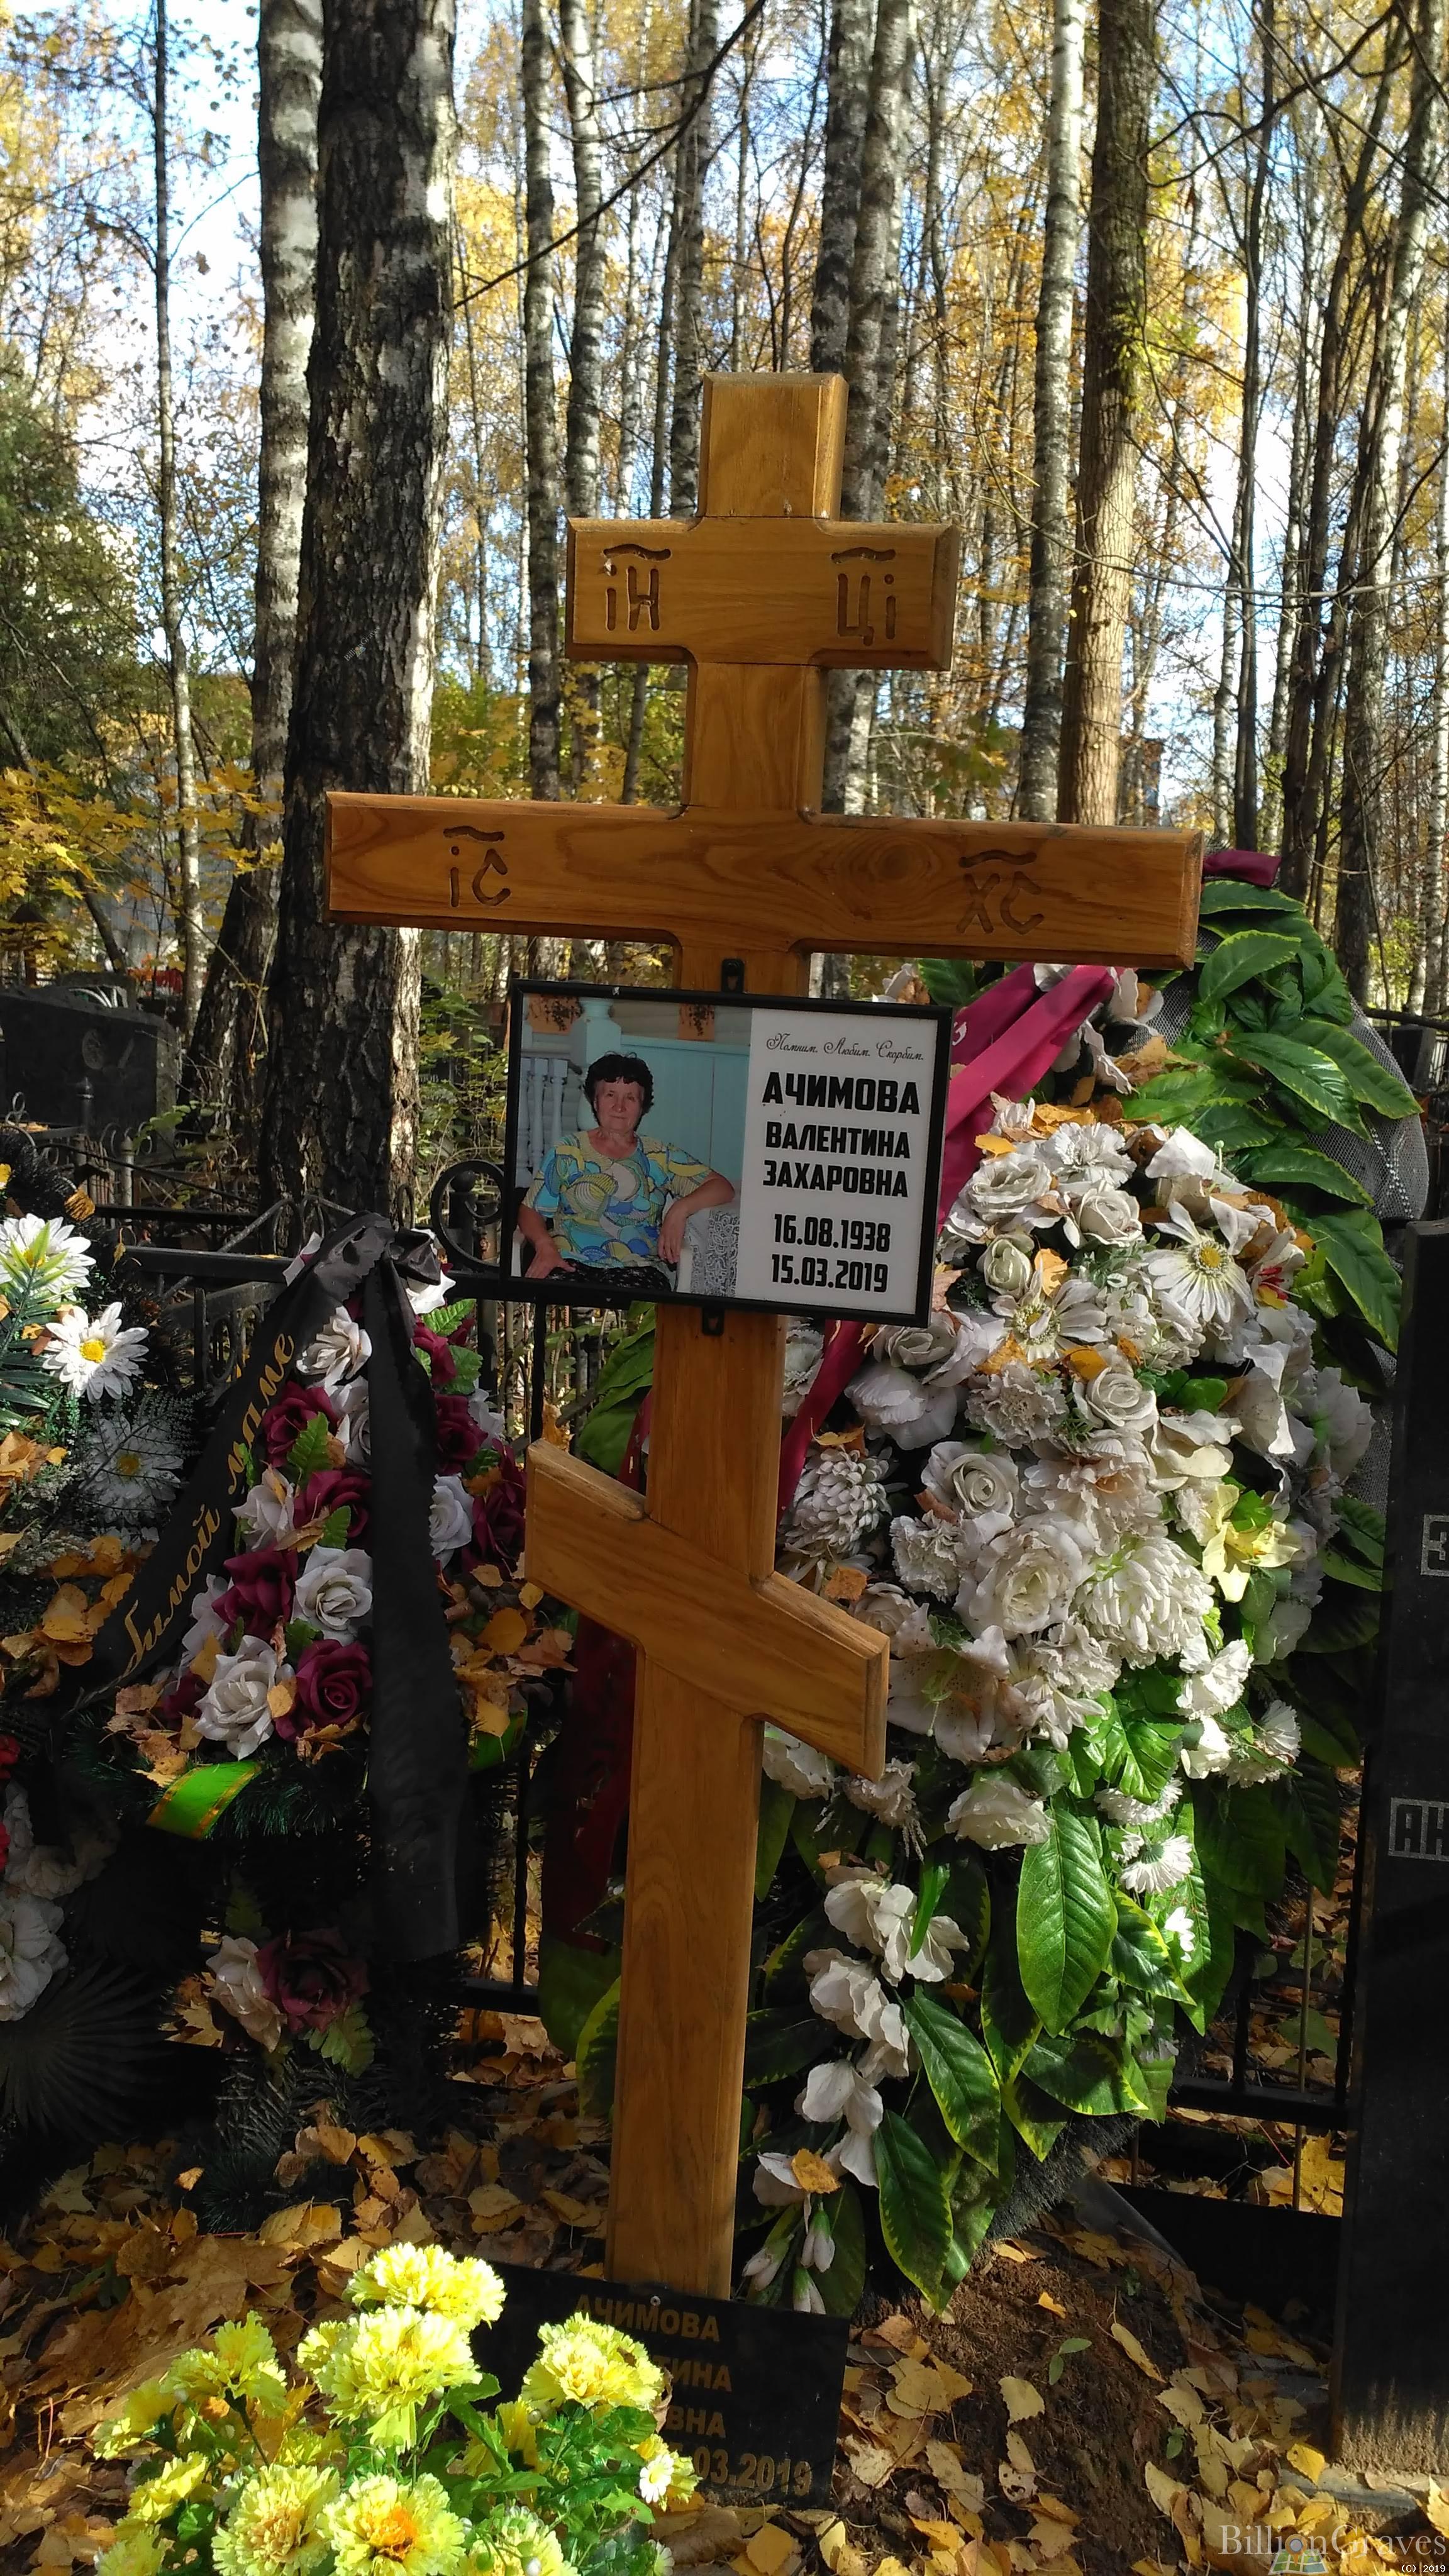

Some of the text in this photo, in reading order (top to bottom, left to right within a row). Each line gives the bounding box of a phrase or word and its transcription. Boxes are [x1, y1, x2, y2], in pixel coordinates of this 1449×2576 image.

[765, 1033, 924, 1064] Помним. Любим. Скорбим.
[762, 1071, 920, 1115] АЧИМОВА
[765, 1121, 911, 1160] ВАЛЕНТИНА
[762, 1160, 909, 1198] ЗАХАРОВНА
[774, 1213, 891, 1253] 16.08.1938
[771, 1253, 889, 1293] 15.03.2019
[121, 1503, 222, 1680] бимой
